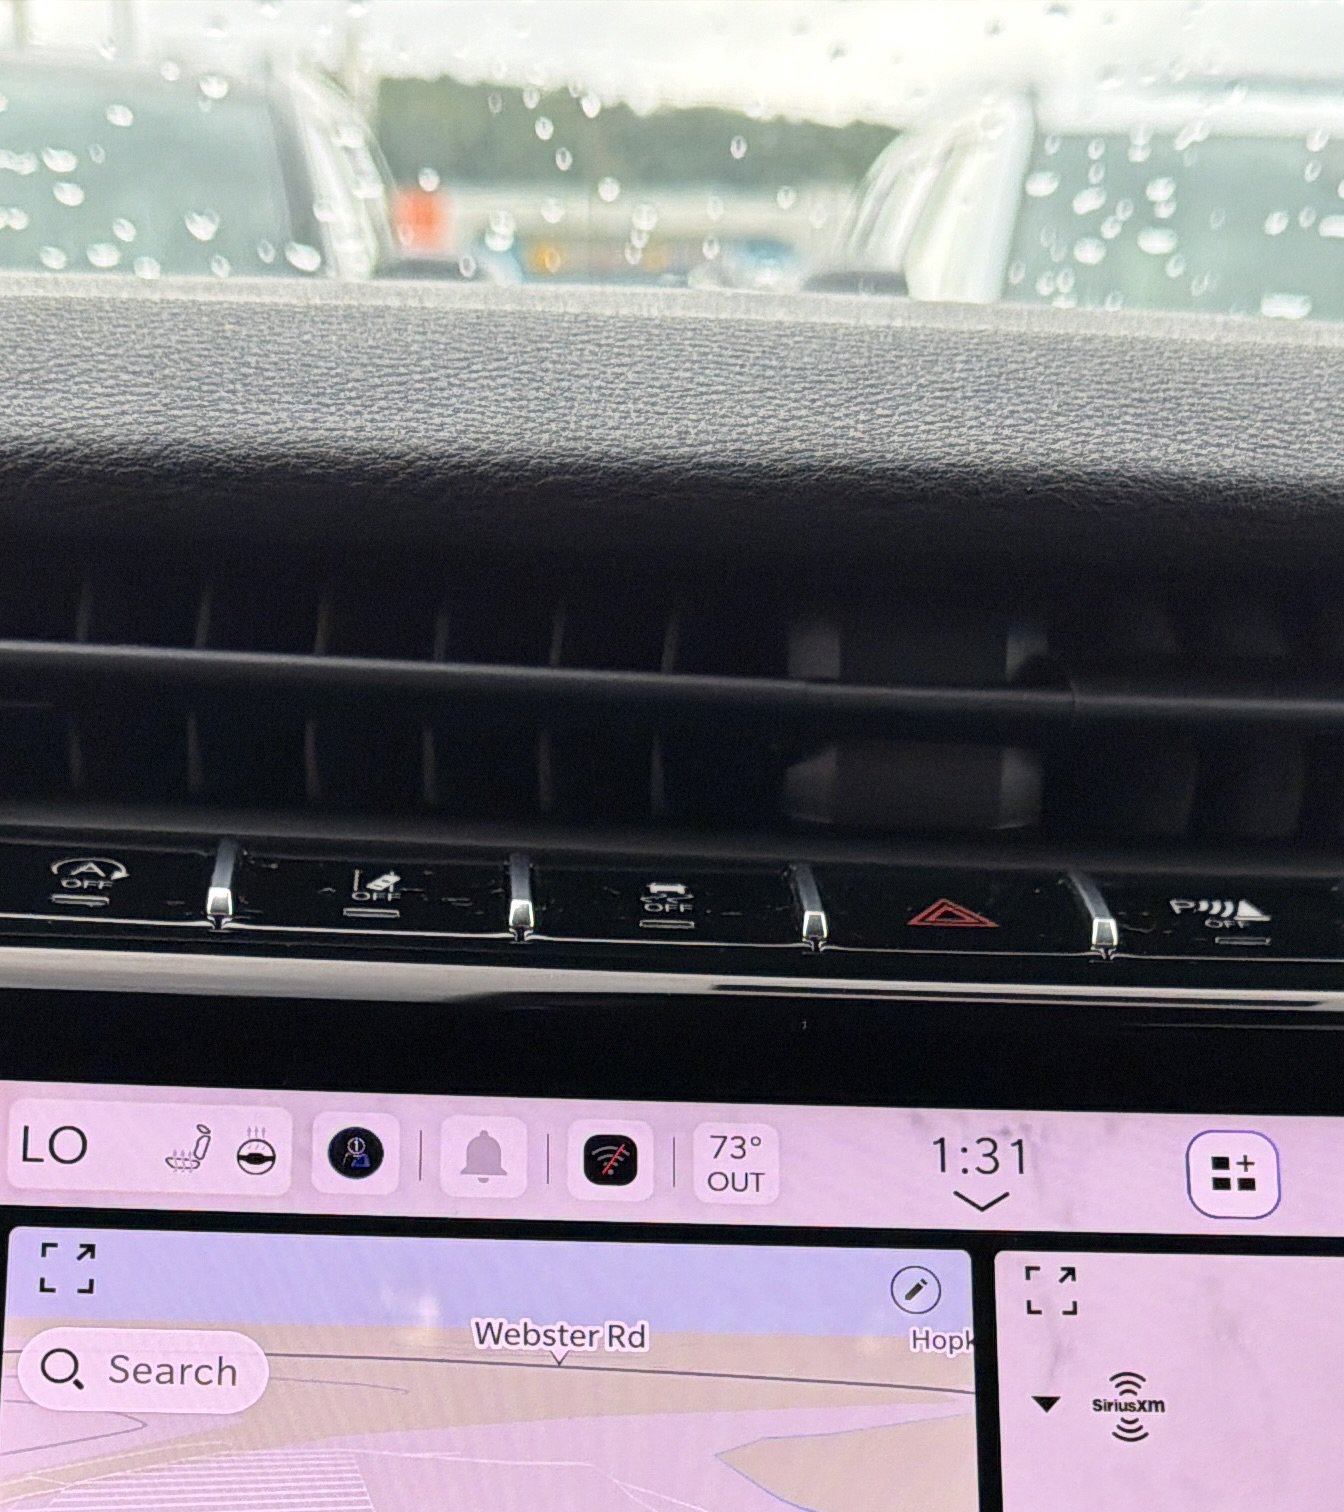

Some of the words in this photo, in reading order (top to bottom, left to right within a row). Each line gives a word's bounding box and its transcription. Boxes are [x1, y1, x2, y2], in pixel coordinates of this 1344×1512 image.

[61, 879, 114, 889] OFF
[351, 888, 403, 902] OFF
[644, 901, 693, 914] OFF
[1204, 918, 1252, 930] OFF
[22, 1125, 87, 1165] LO
[709, 1135, 762, 1161] 73°
[931, 1137, 1027, 1175] 1:31
[708, 1172, 765, 1194] OUT
[474, 1320, 600, 1350] Webster
[607, 1321, 646, 1350] Rd
[108, 1354, 237, 1386] Search
